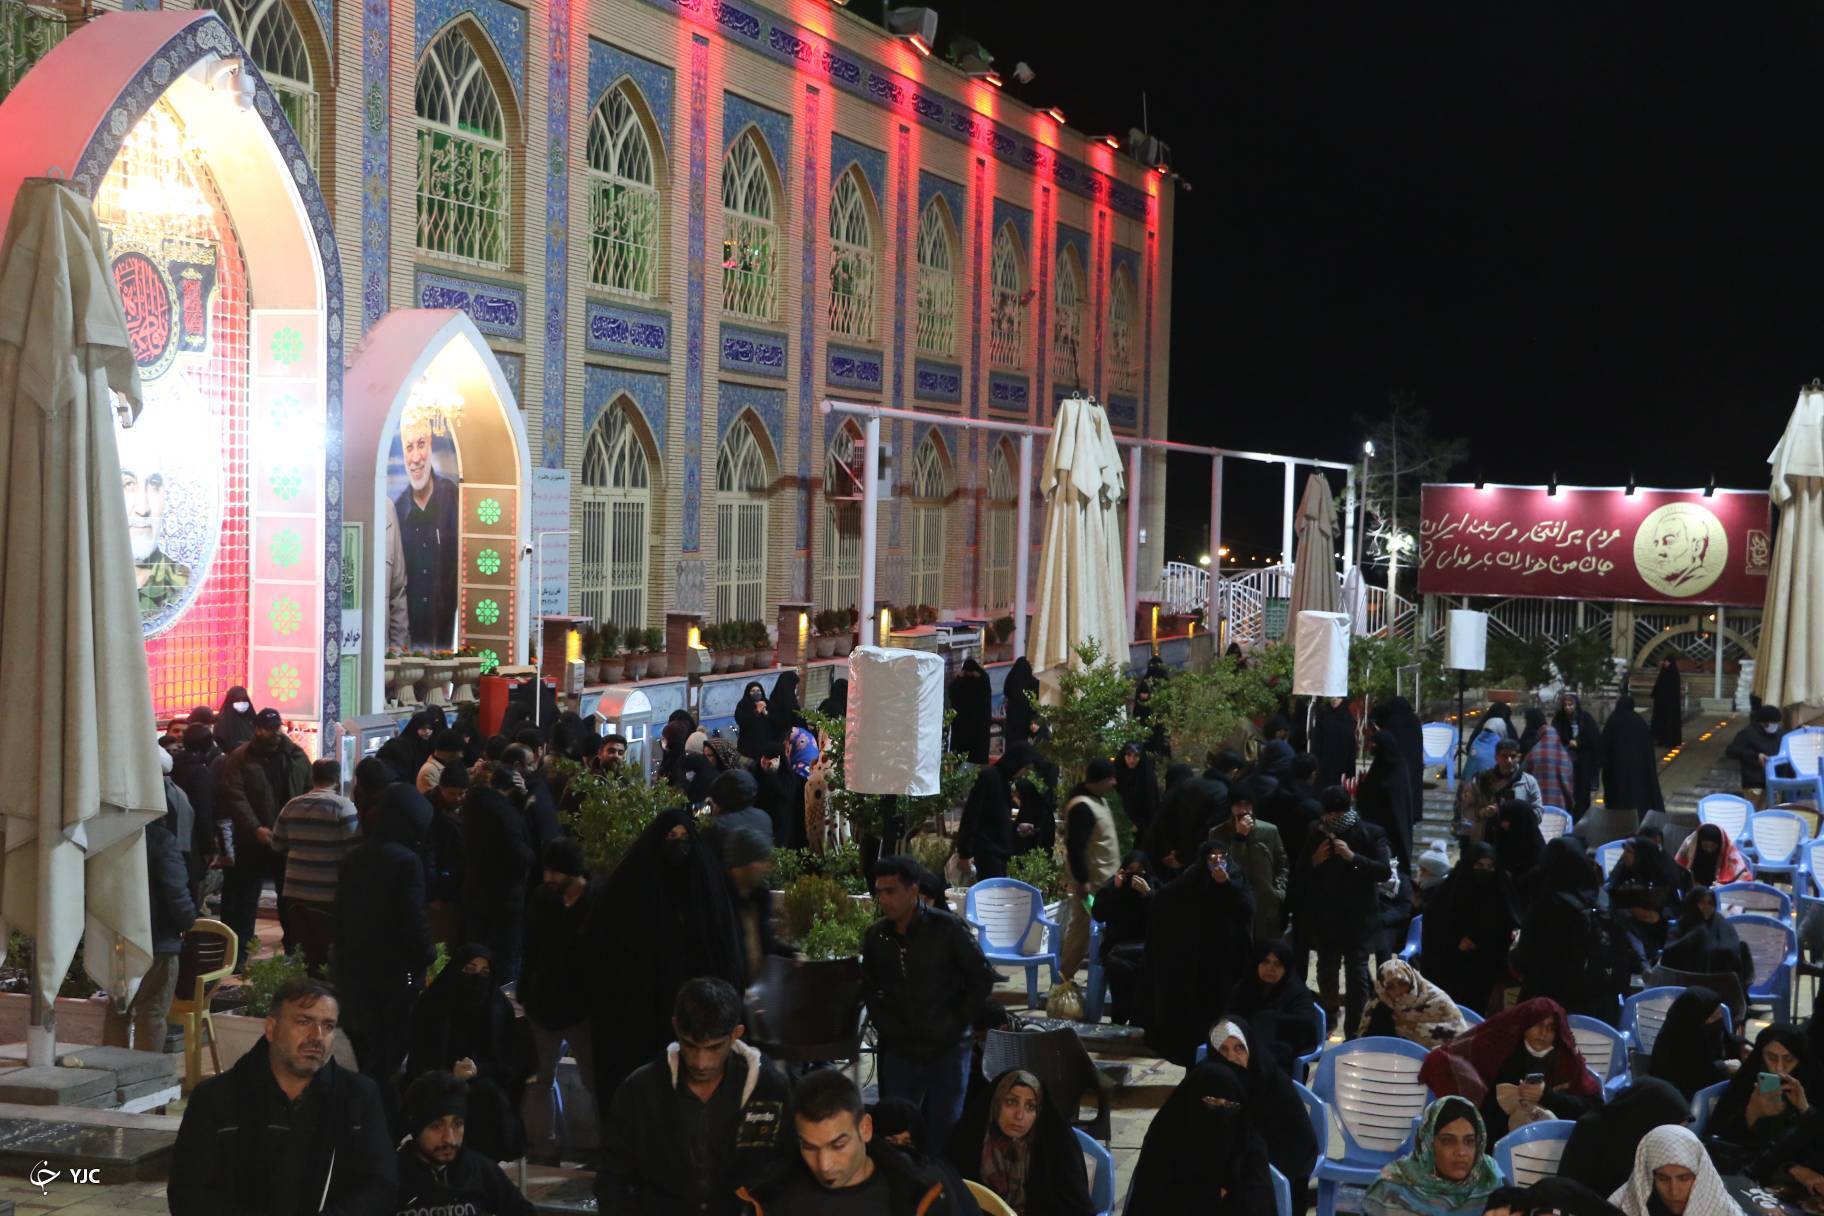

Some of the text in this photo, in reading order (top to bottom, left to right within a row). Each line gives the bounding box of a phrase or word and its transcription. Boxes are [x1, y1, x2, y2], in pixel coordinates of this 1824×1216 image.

[1419, 512, 1470, 540] ایران
[1586, 528, 1621, 553] مردم
[1549, 555, 1578, 575] من
[1579, 555, 1615, 577] جان
[341, 629, 361, 648] خواهرا
